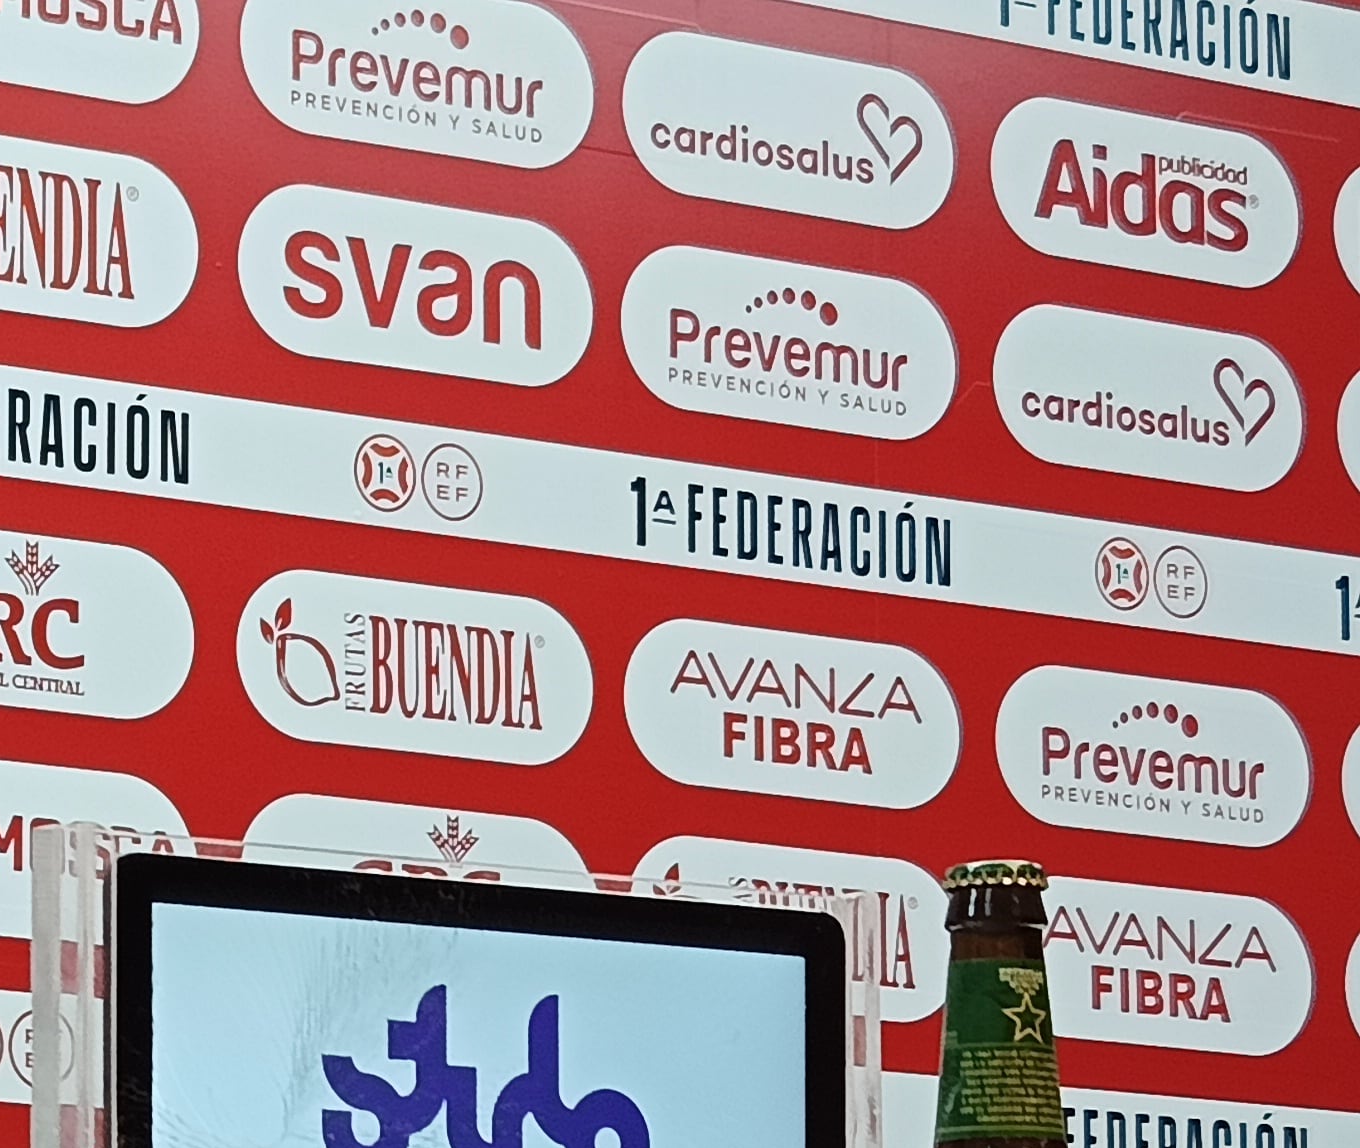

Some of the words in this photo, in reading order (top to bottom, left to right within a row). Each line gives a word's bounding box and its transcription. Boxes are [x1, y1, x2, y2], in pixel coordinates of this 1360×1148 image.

[292, 28, 544, 119] Prevemur
[291, 89, 438, 129] PREVENCIÓN
[449, 114, 460, 131] Y
[471, 116, 544, 144] SALUD
[651, 121, 874, 185] cardiosalus
[1159, 155, 1248, 187] publicidad
[1034, 138, 1250, 253] Aidas
[283, 229, 542, 351] svan
[669, 308, 908, 393] Prevemur
[668, 367, 808, 402] PREVENCIÓN
[818, 389, 829, 404] Y
[840, 391, 907, 417] SALUD
[1021, 390, 1231, 448] cardiosalus
[11, 673, 85, 698] CENTRAL
[344, 611, 366, 712] FRUTAS
[670, 650, 923, 725] AVANZA
[722, 712, 873, 776] FIBRA
[1041, 726, 1265, 801] Prevemur
[1041, 783, 1171, 815] PREVENCIÓN
[1180, 801, 1192, 816] Y
[1201, 801, 1265, 825] SALUD
[1043, 905, 1277, 973] AVANZA
[1091, 965, 1232, 1023] FIBRA
